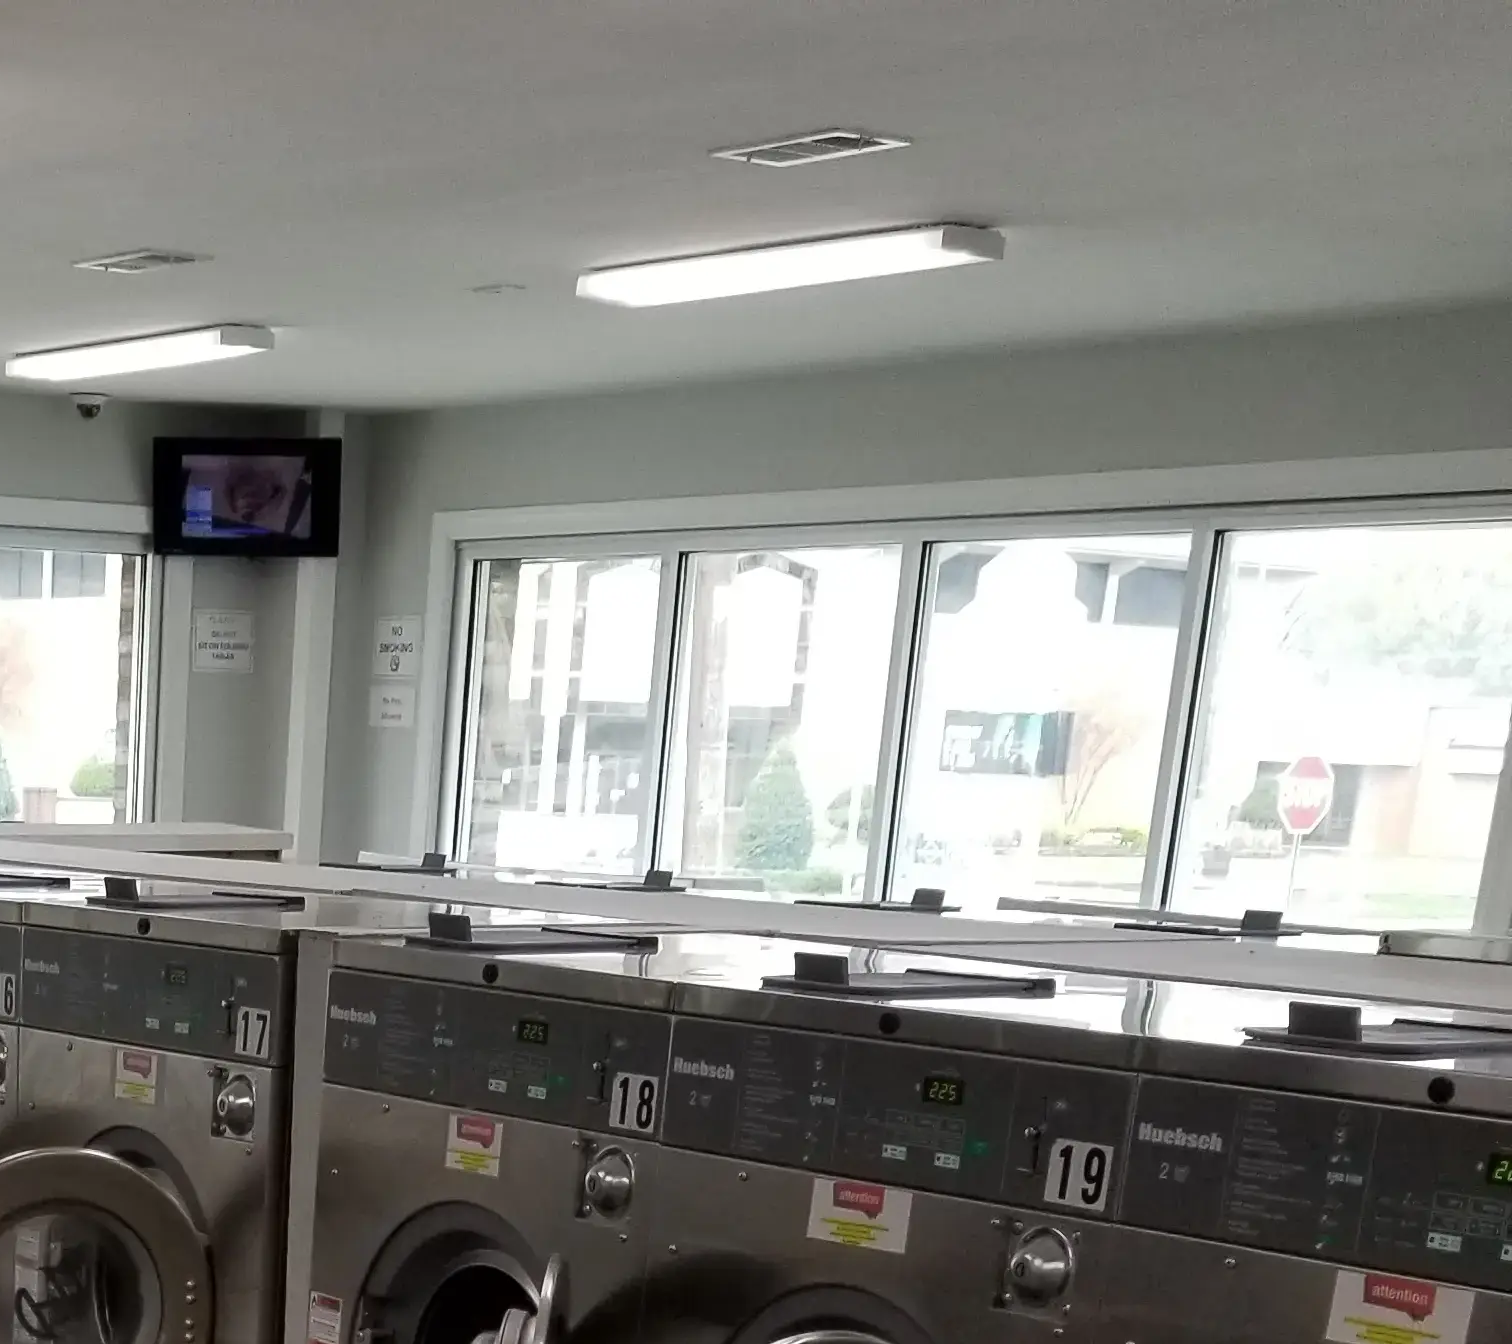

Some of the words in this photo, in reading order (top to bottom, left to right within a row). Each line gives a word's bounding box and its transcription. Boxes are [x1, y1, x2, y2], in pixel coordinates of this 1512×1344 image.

[391, 626, 403, 637] NO
[379, 642, 414, 653] SMOKING
[240, 1010, 268, 1056] 17
[673, 1056, 735, 1081] Huebsch
[618, 1076, 655, 1130] 18
[929, 1081, 957, 1101] 225
[1138, 1121, 1223, 1153] Huebsch
[1057, 1144, 1107, 1205] 19
[1371, 1283, 1429, 1306] attention
